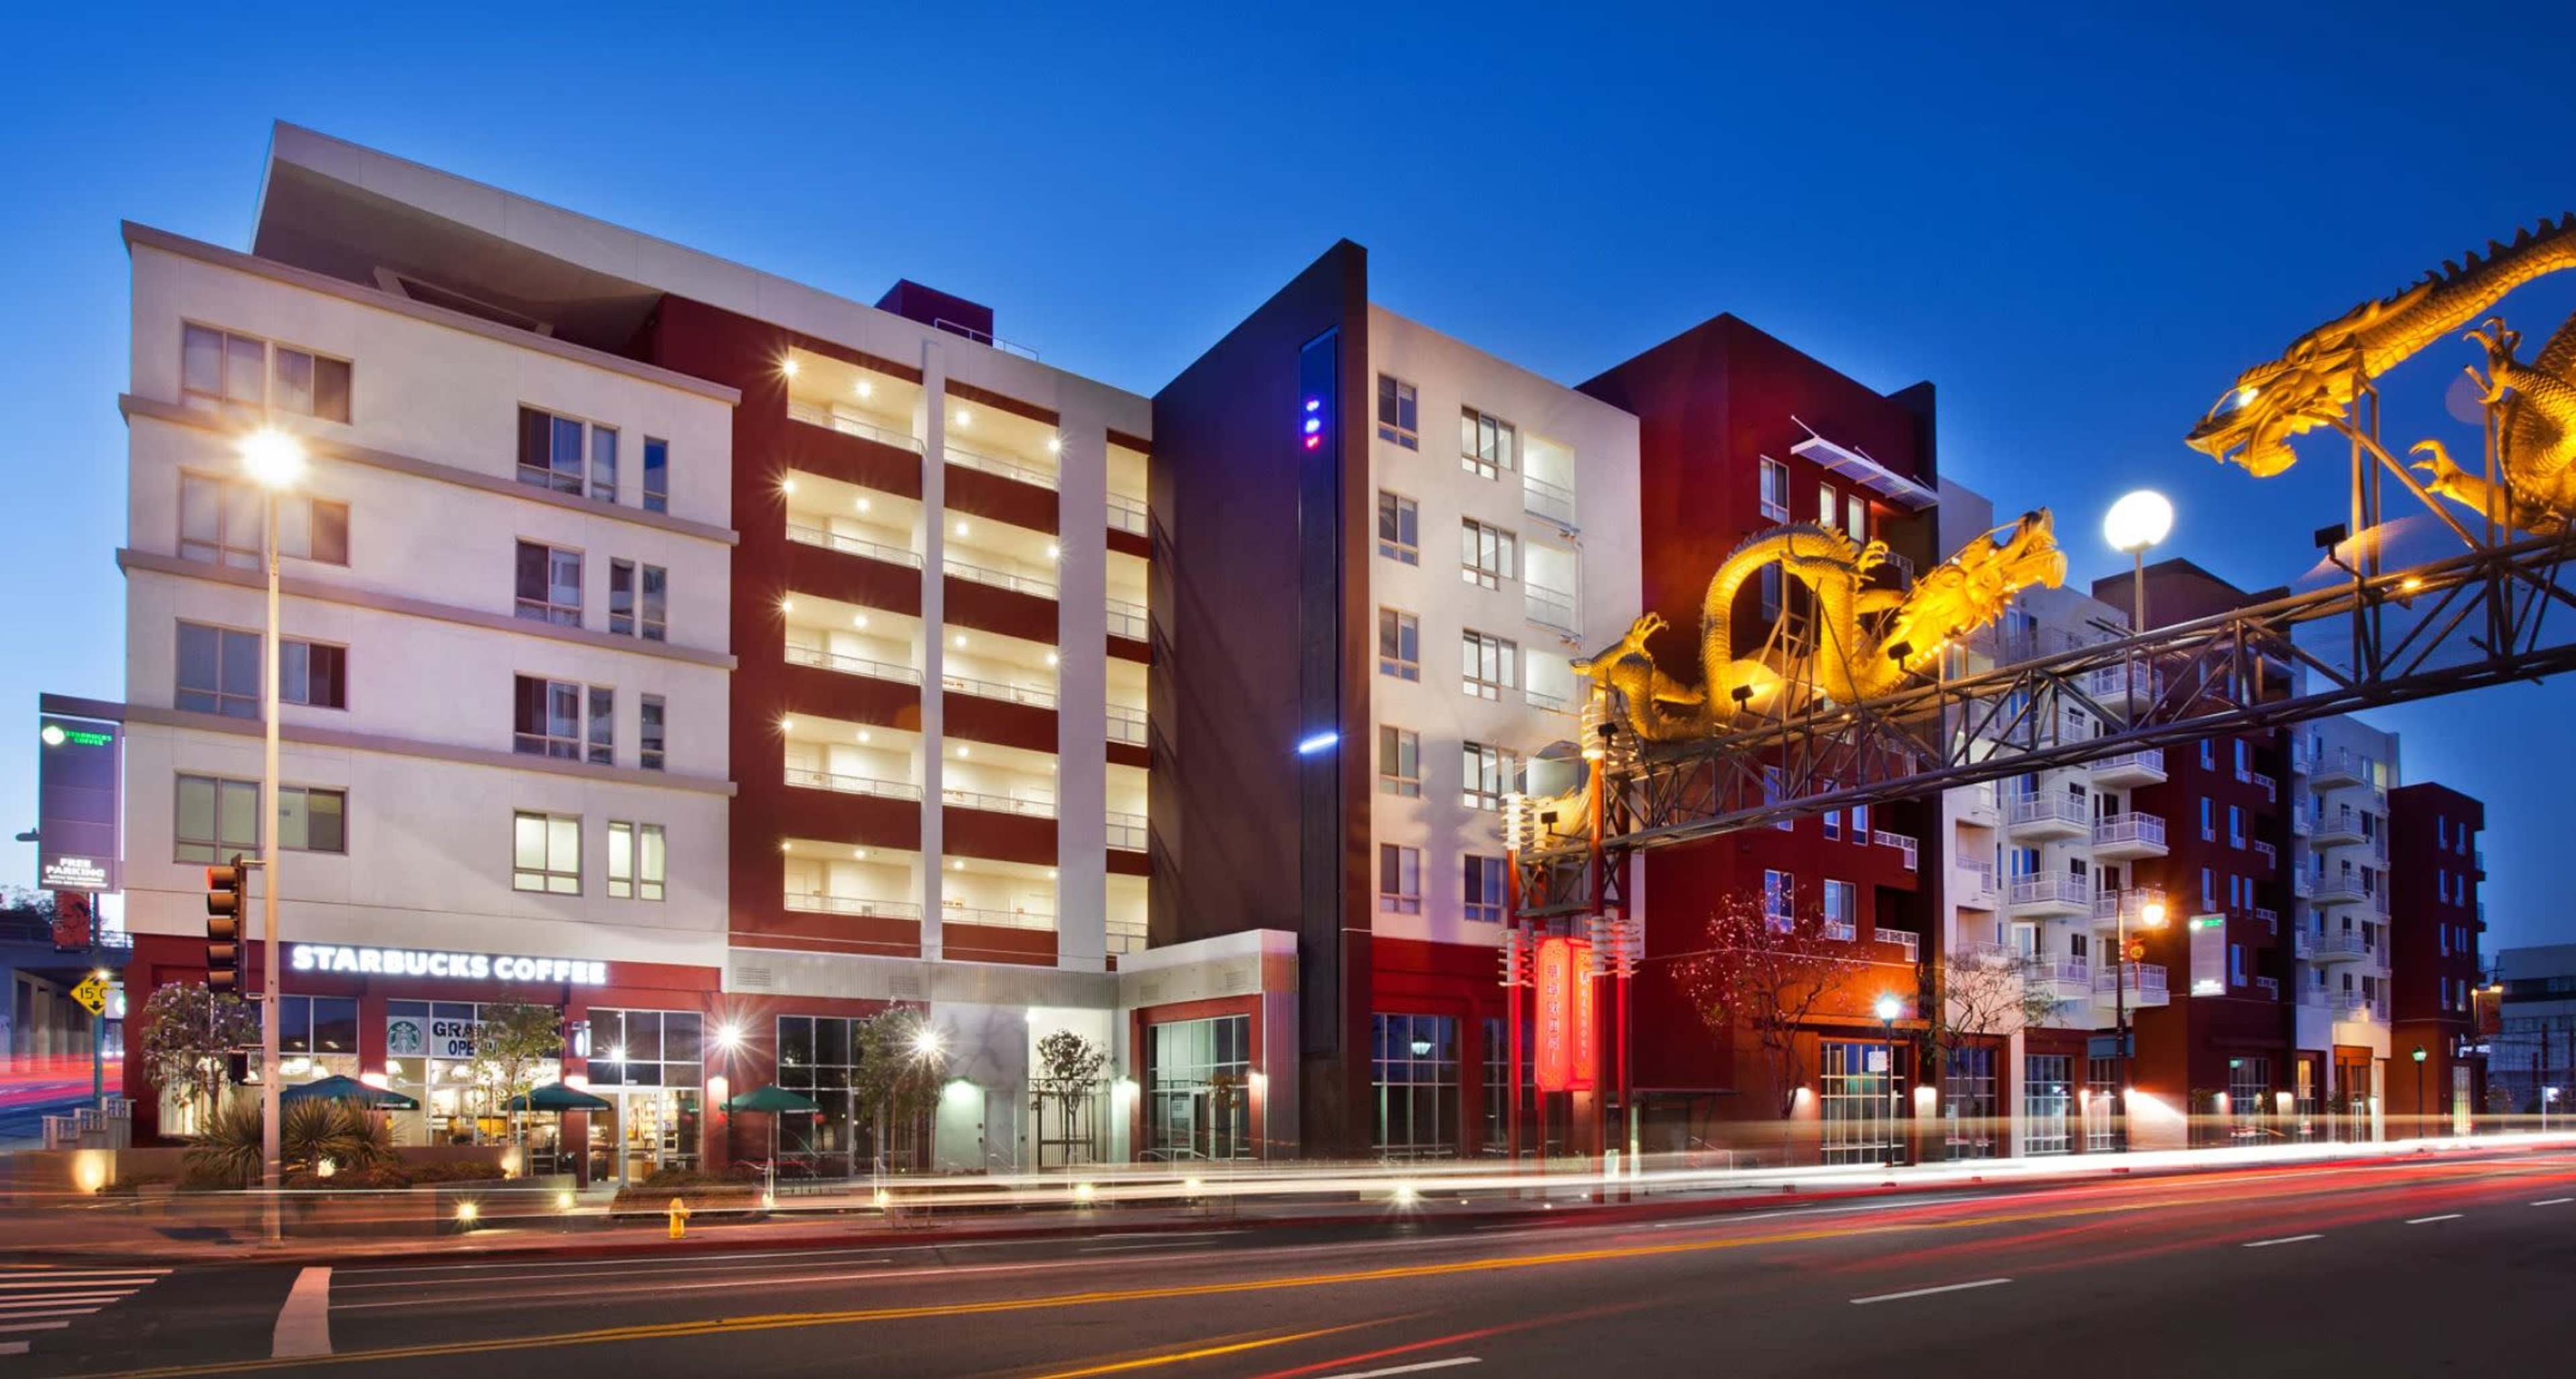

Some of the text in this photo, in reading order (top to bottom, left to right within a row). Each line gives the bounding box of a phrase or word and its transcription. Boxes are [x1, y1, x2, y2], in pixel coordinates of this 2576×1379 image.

[60, 858, 92, 868] FREE
[46, 866, 105, 877] PARKING
[292, 945, 606, 984] STARBUCKS COFFEE
